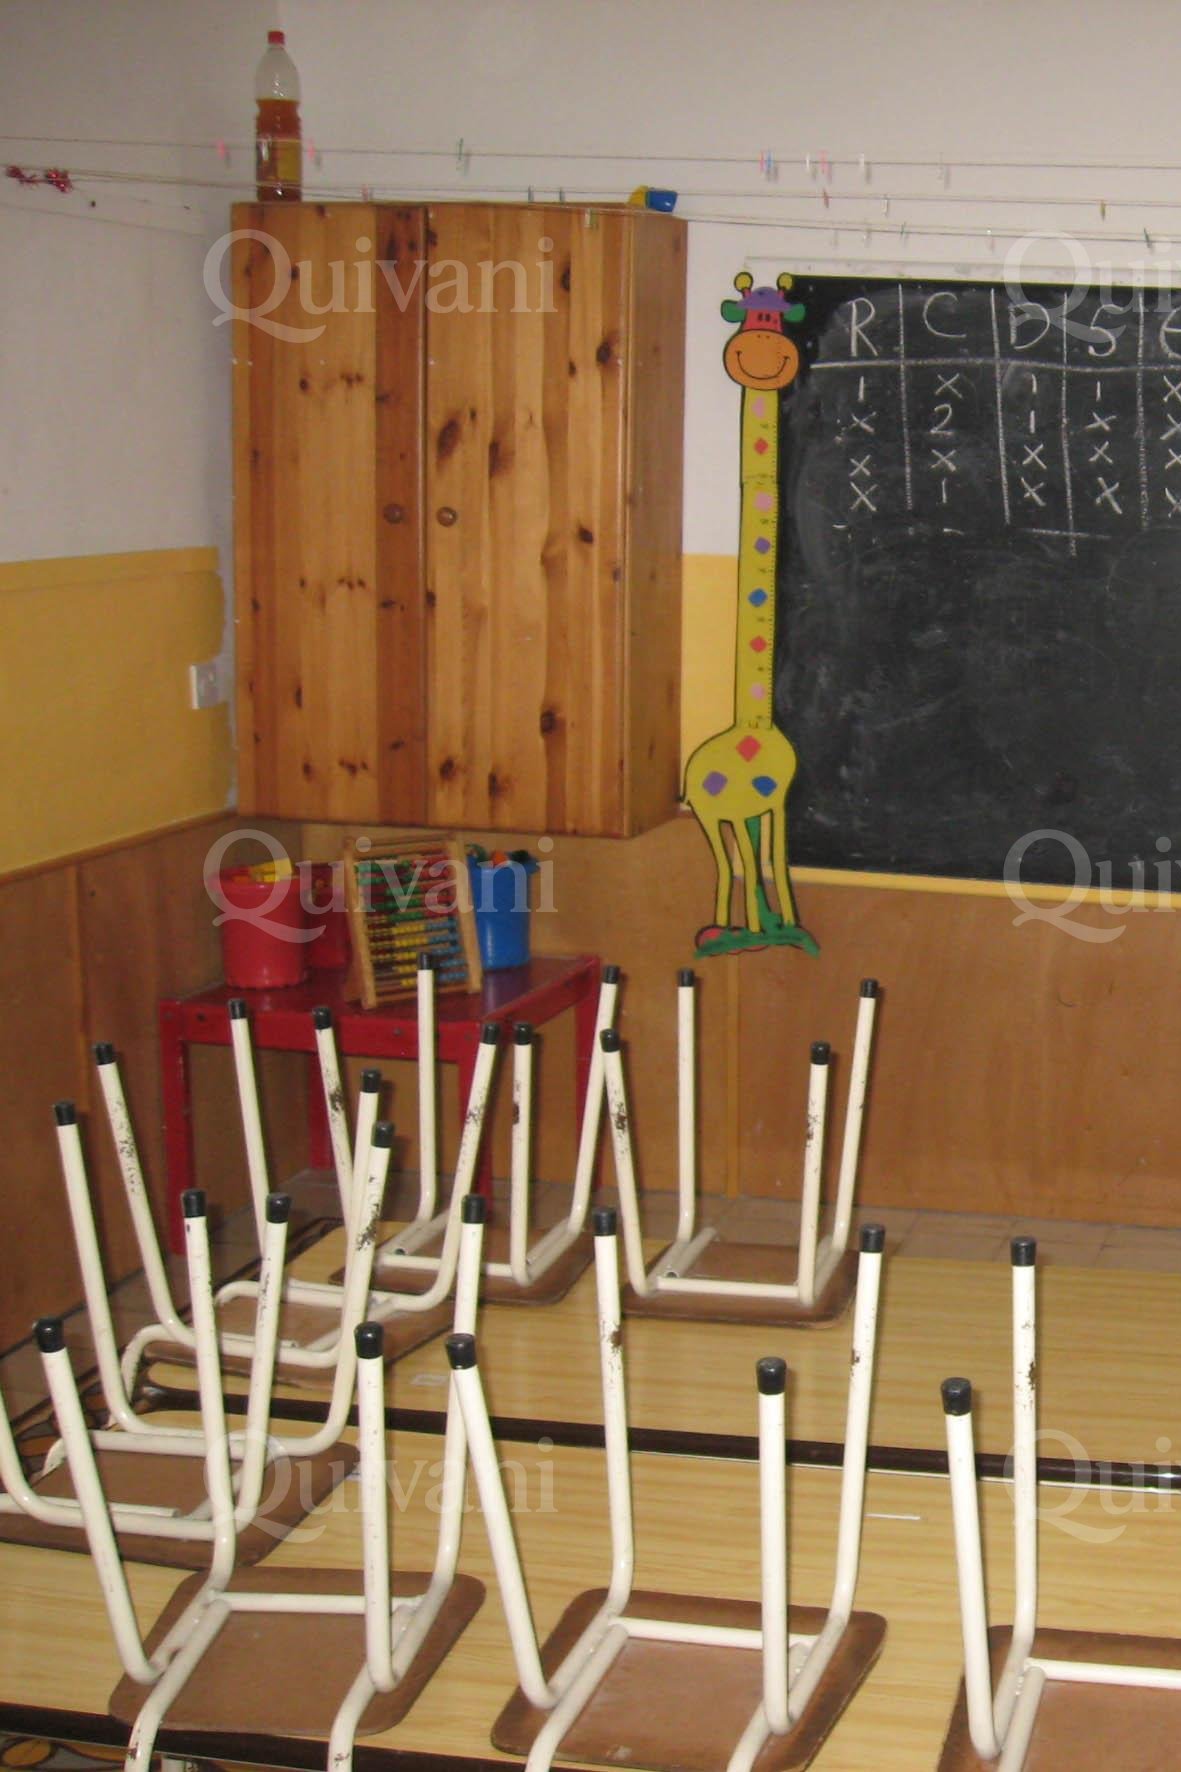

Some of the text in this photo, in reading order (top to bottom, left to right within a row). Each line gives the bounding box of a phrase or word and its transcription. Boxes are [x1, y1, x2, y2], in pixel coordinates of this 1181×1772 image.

[847, 297, 878, 357] R
[923, 291, 967, 338] C
[1009, 302, 1050, 350] D
[1088, 304, 1124, 356] S
